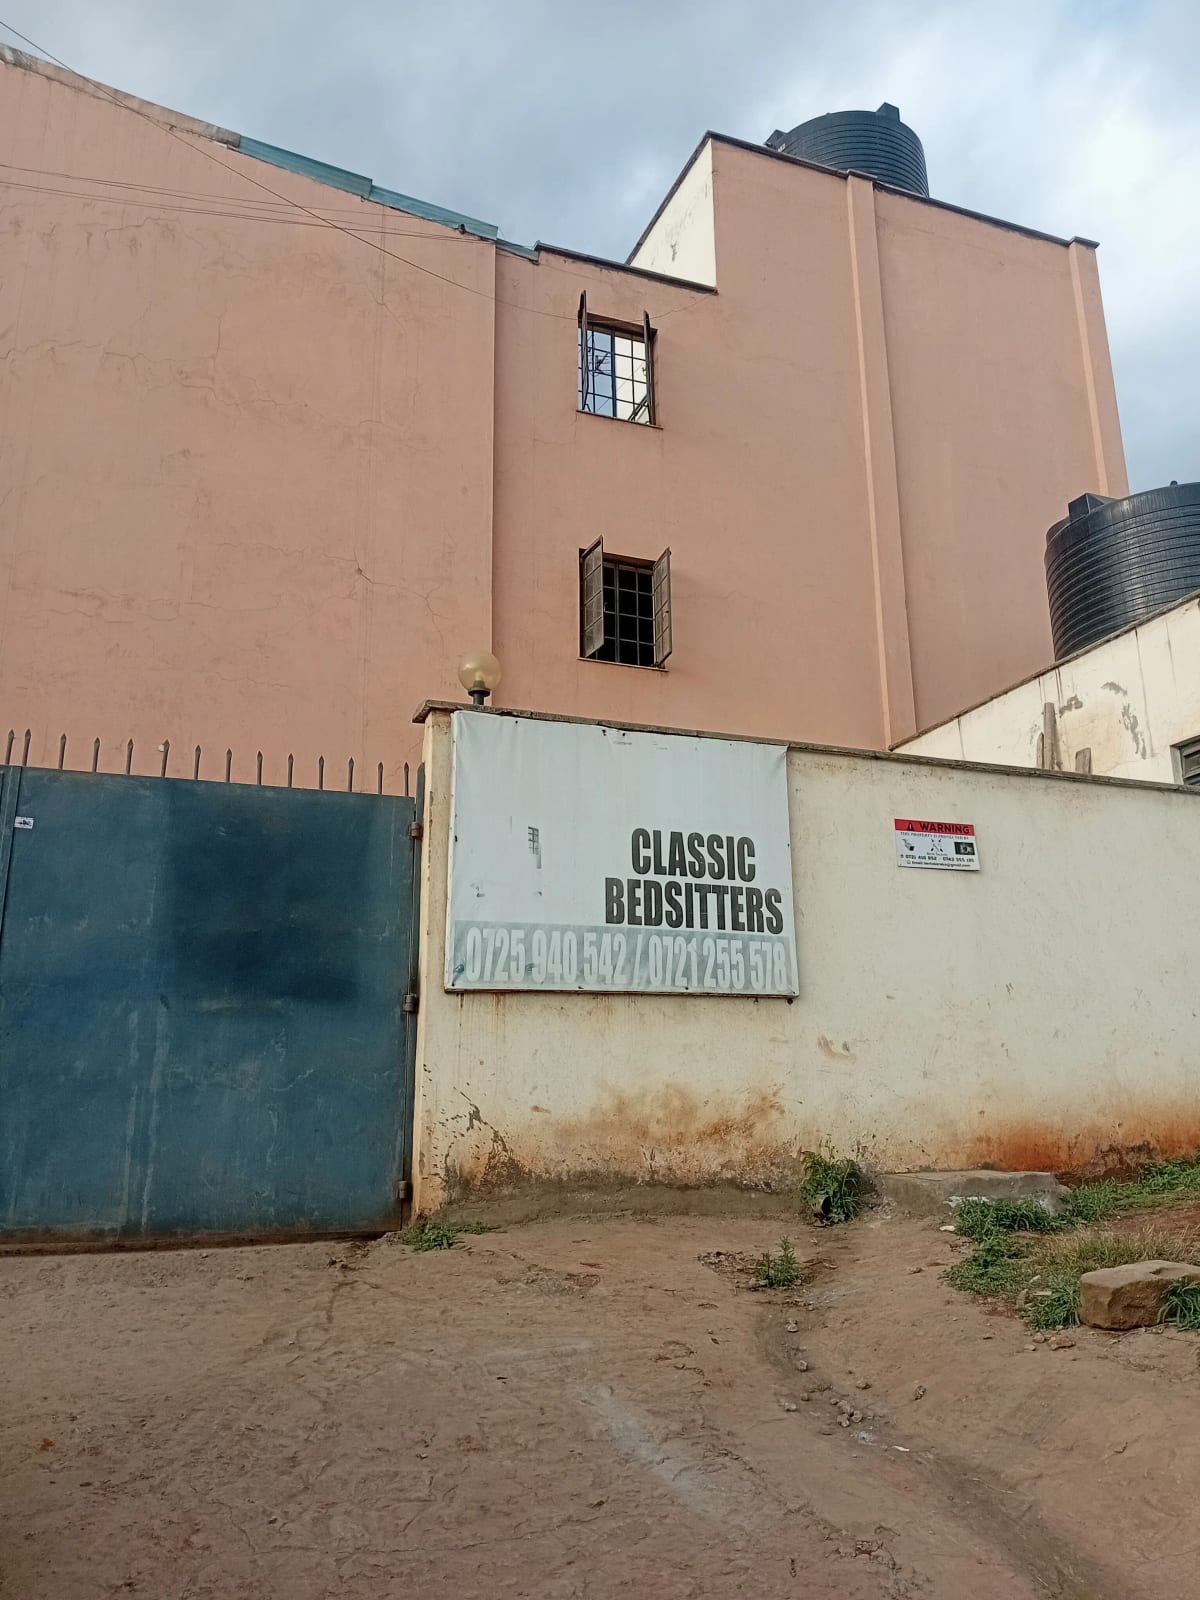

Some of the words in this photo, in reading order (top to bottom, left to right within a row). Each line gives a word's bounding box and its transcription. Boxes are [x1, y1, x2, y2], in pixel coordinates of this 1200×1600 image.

[631, 827, 756, 883] CLASSIC
[919, 822, 970, 835] WARNING
[605, 877, 784, 935] BEDSITTERS
[466, 926, 526, 983] 0725
[532, 929, 578, 985] 940
[583, 931, 627, 986] 542
[631, 933, 643, 988] /
[648, 934, 698, 988] 0721
[702, 938, 746, 989] 255
[749, 940, 787, 991] 578
